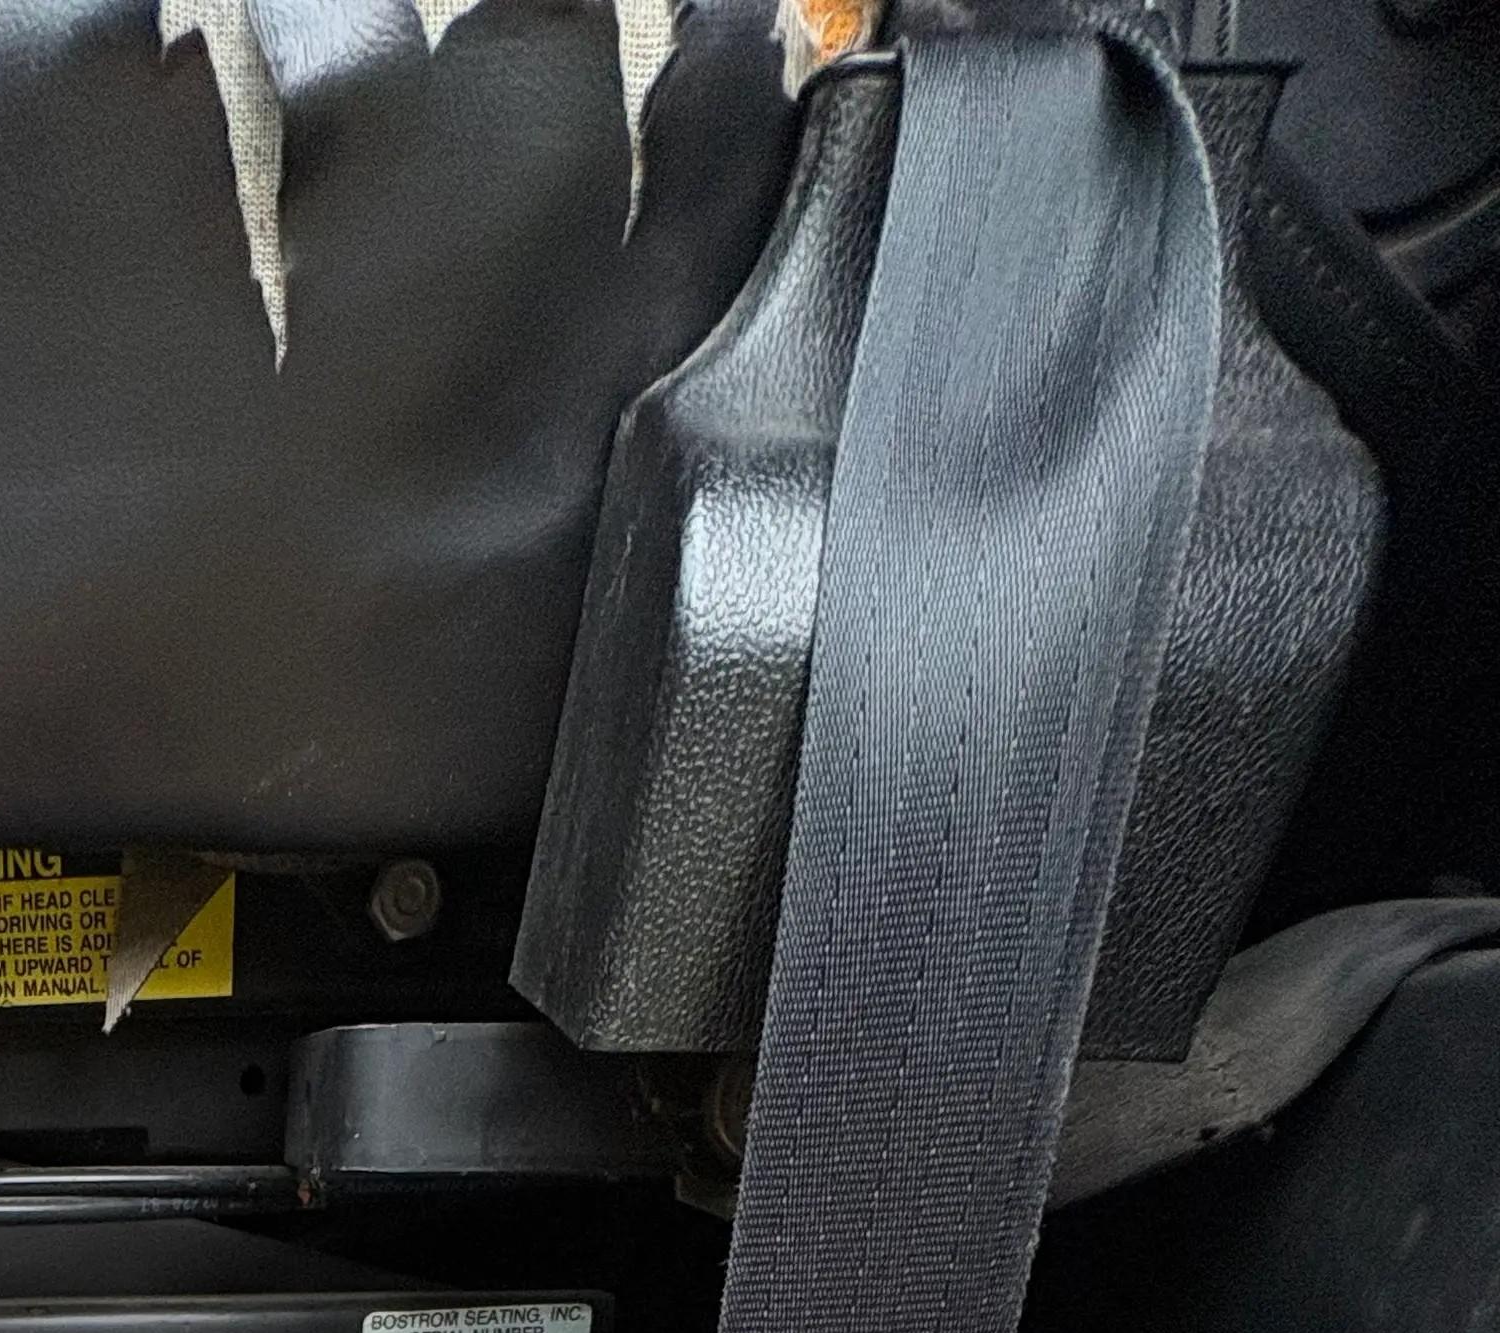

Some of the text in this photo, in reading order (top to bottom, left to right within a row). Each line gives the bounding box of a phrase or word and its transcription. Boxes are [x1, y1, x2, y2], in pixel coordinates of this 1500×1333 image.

[21, 891, 71, 910] HEAD
[80, 912, 106, 929] OR
[56, 936, 72, 953] IS
[15, 956, 92, 976] UPWARD
[177, 951, 203, 968] OF
[24, 977, 105, 996] MANUAL.
[371, 1306, 585, 1330] BOSTROM SEATING, INC.
